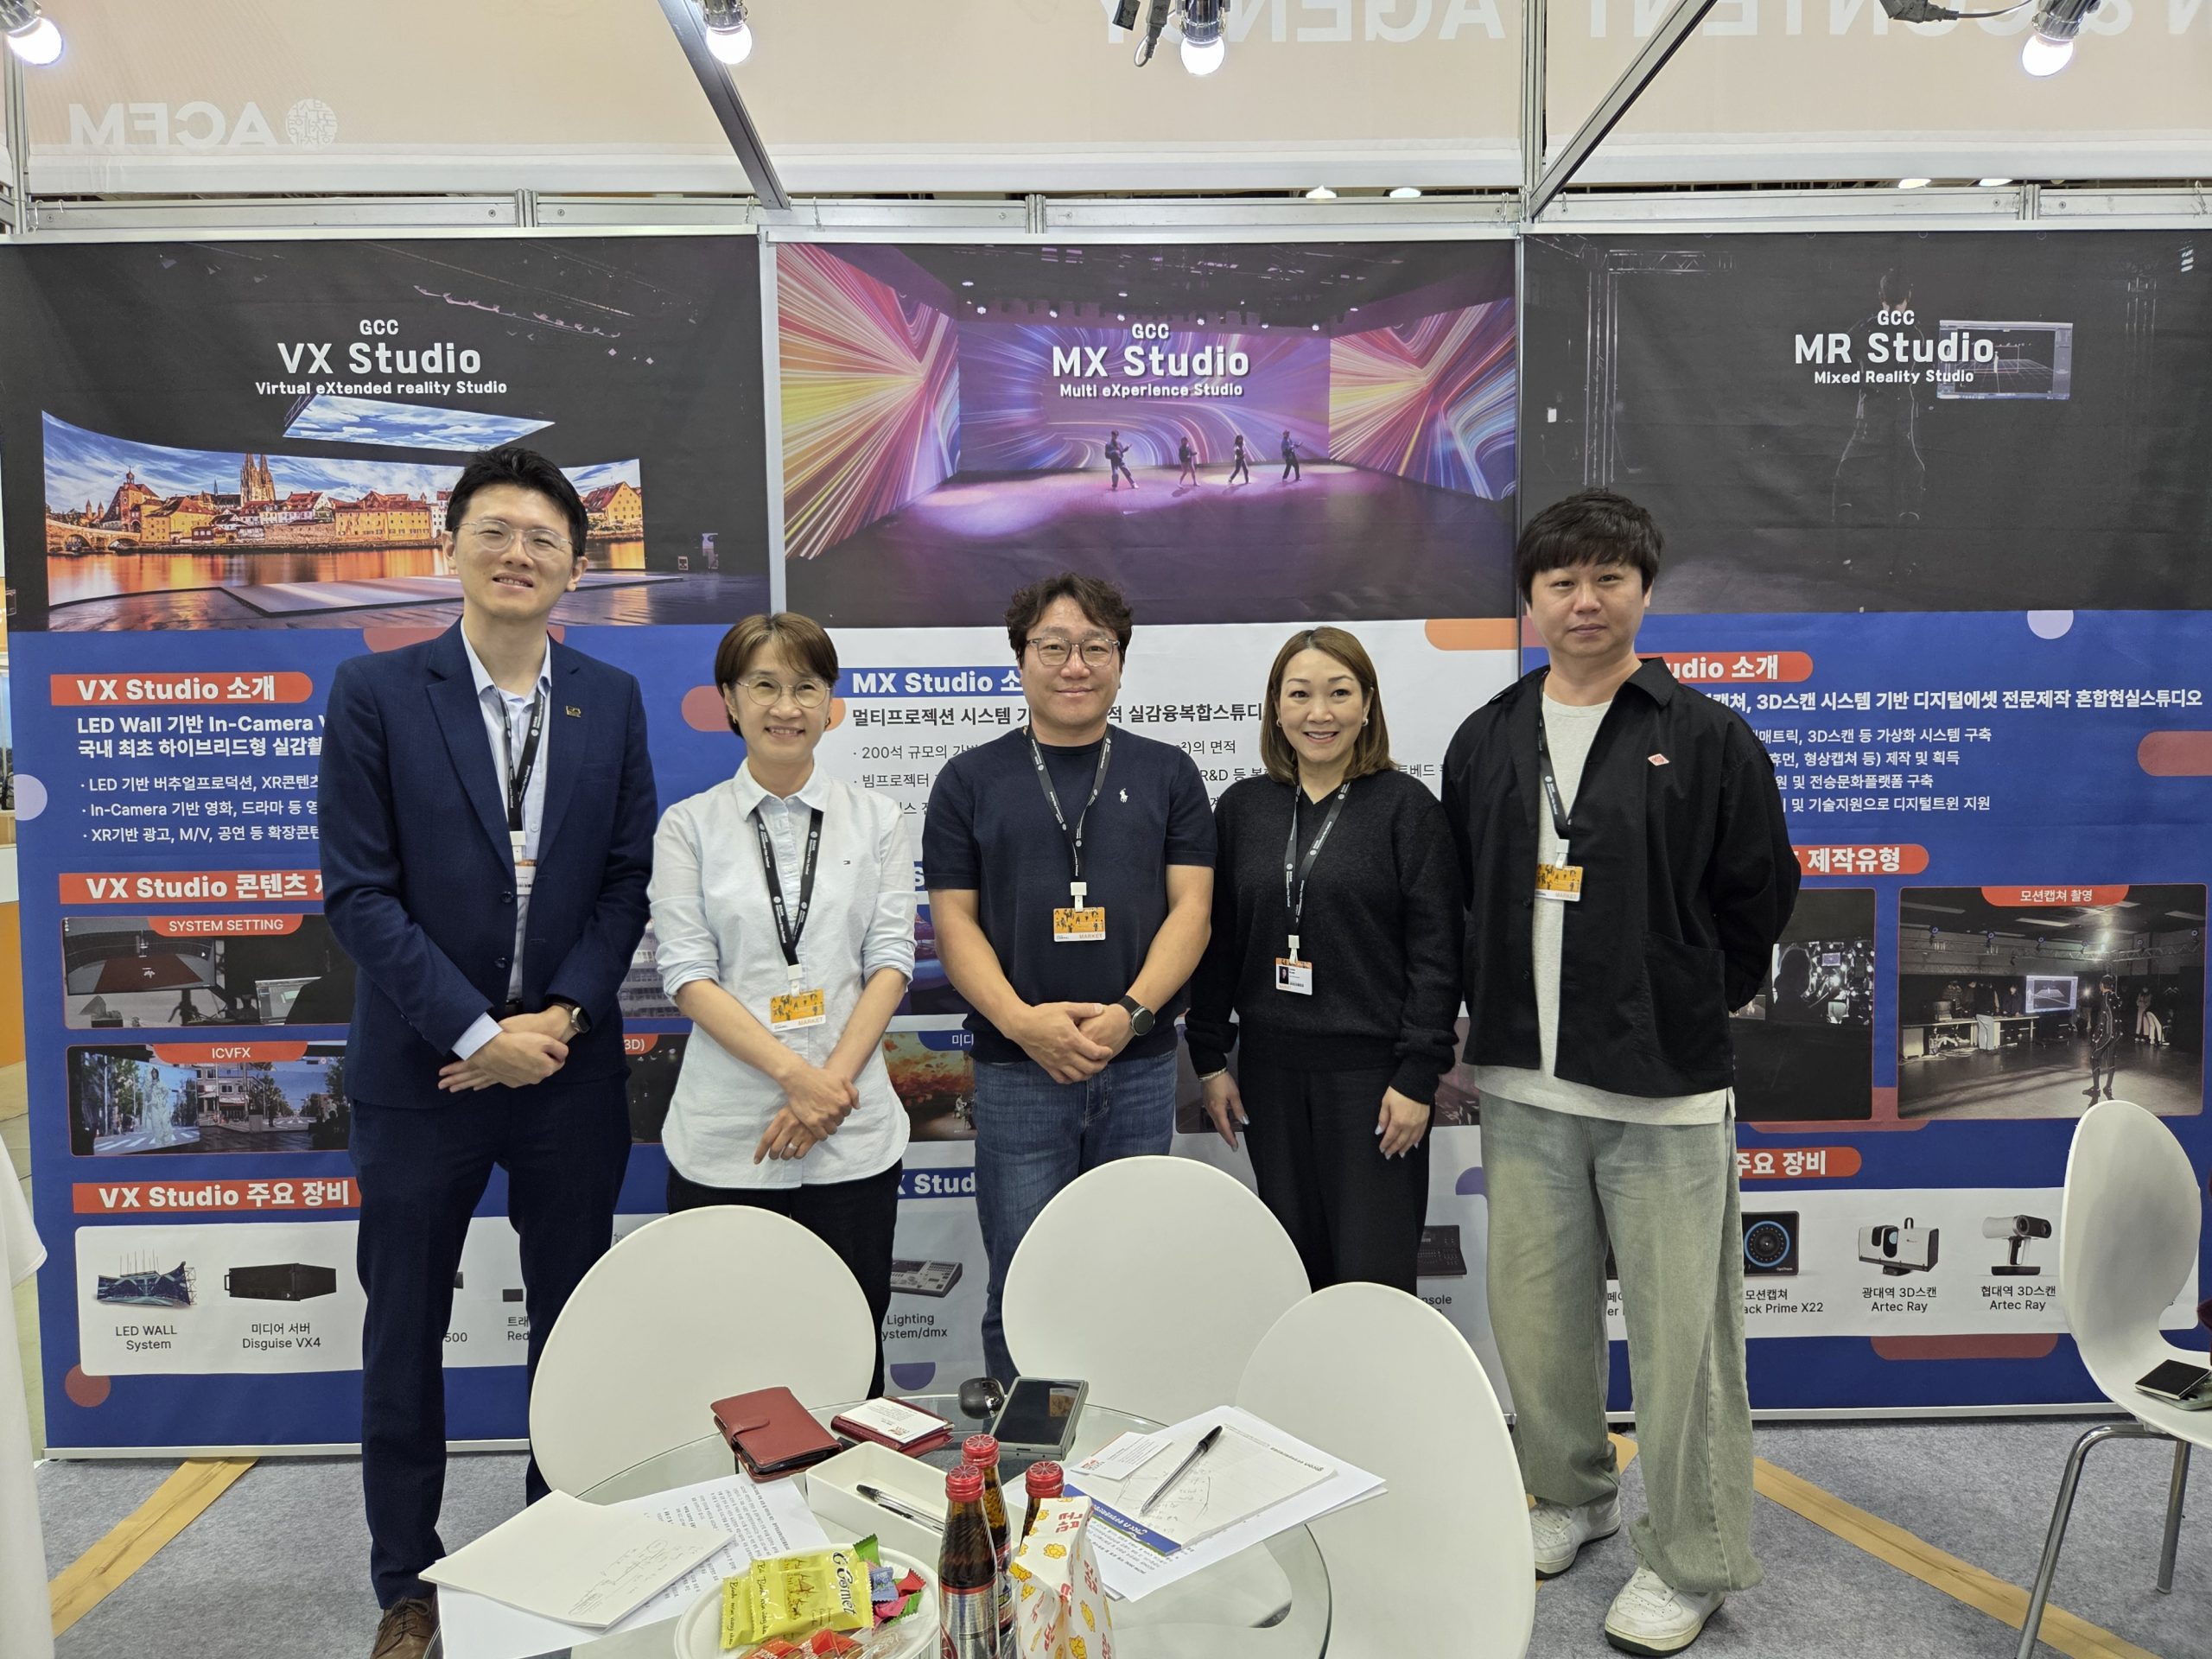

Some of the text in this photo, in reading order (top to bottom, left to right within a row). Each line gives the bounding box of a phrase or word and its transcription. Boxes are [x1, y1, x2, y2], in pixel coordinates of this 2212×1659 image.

[1877, 310, 1915, 326] GCC
[359, 319, 399, 335] GCC
[1131, 323, 1170, 340] GCC
[1795, 332, 1994, 364] MR Studio
[277, 342, 481, 374] VX Studio
[1052, 346, 1249, 378] MX Studio
[1815, 370, 1974, 385] Mixed Reality Studio
[256, 380, 507, 395] Virtual eXtended reality Studio
[1060, 383, 1243, 399] Multi eXperience Studio
[1732, 655, 1779, 680] 소개
[76, 675, 276, 701] VX Studio 소개
[852, 672, 897, 693] MX
[905, 671, 993, 692] Studio
[1757, 693, 1815, 710] 3D스캔
[1821, 692, 1871, 710] 시스템
[1875, 692, 1909, 709] 기반
[1913, 690, 1998, 709] 디지털에셋
[2002, 690, 2071, 709] 전문제작
[2075, 689, 2203, 708] 혼합현실스튜디오
[78, 717, 115, 734] LED
[119, 716, 162, 733] Wall
[168, 715, 203, 733] 기반
[209, 715, 313, 732] In-Camera
[853, 708, 954, 727] 멀티프로젝션
[961, 707, 1010, 726] 시스템
[1808, 730, 1855, 744] 3D스캔
[1859, 729, 1872, 744] 등
[1877, 729, 1916, 743] 가상화
[1920, 728, 1961, 743] 시스템
[1964, 728, 1992, 742] 구축
[78, 740, 112, 759] 국내
[118, 739, 154, 758] 최초
[159, 737, 266, 757] 하이브리드형
[861, 746, 903, 760] 200석
[908, 745, 947, 760] 규모의
[1211, 741, 1236, 754] 면적
[1804, 753, 1858, 767] 형상캡쳐
[1862, 753, 1882, 767] 등)
[1885, 752, 1911, 766] 제작
[1916, 752, 1928, 766] 및
[1932, 751, 1961, 766] 획득
[89, 778, 118, 791] LED
[122, 777, 149, 791] 기반
[154, 776, 257, 791] 버추얼프로덕션,
[862, 774, 930, 788] 빔프로젝터
[1793, 775, 1805, 790] 및
[1809, 774, 1904, 790] 전승문화플랫폼
[1907, 774, 1934, 788] 구축
[90, 804, 167, 817] In-Camera
[172, 802, 200, 817] 기반
[204, 801, 237, 817] 영화,
[242, 800, 283, 816] 드라마
[288, 800, 302, 815] 등
[1791, 795, 1991, 812] 및 기술지원으로 디지털트윈 지원
[92, 828, 139, 842] XR기반
[143, 827, 175, 843] 광고,
[180, 827, 213, 843] M/V,
[218, 825, 245, 841] 공연
[250, 826, 263, 841] 등
[1808, 846, 1901, 873] 제작유형
[86, 878, 129, 899] VX
[137, 876, 227, 899] Studio
[235, 873, 308, 899] 콘텐츠
[2020, 888, 2093, 903] 모션캡쳐 촬영
[168, 919, 283, 932] SYSTEM SETTING
[212, 1047, 251, 1059] ICVFX
[1783, 1150, 1827, 1176] 장비
[99, 1180, 349, 1208] VX Studio 주요 장비
[1745, 1289, 1788, 1301] 모션캡쳐
[1862, 1287, 1937, 1299] 광대역 3D스캔
[2018, 1286, 2056, 1297] 3D스캔
[1765, 1303, 1798, 1314] Prime
[1802, 1302, 1823, 1313] X22
[1872, 1301, 1928, 1314] Artec Ray
[1990, 1300, 2046, 1313] Artec Ray
[887, 1313, 934, 1326] Lighting
[115, 1325, 178, 1337] LED WALL
[251, 1322, 311, 1335] 미디어 서버
[126, 1339, 171, 1352] System
[242, 1338, 321, 1351] Disguise VX4
